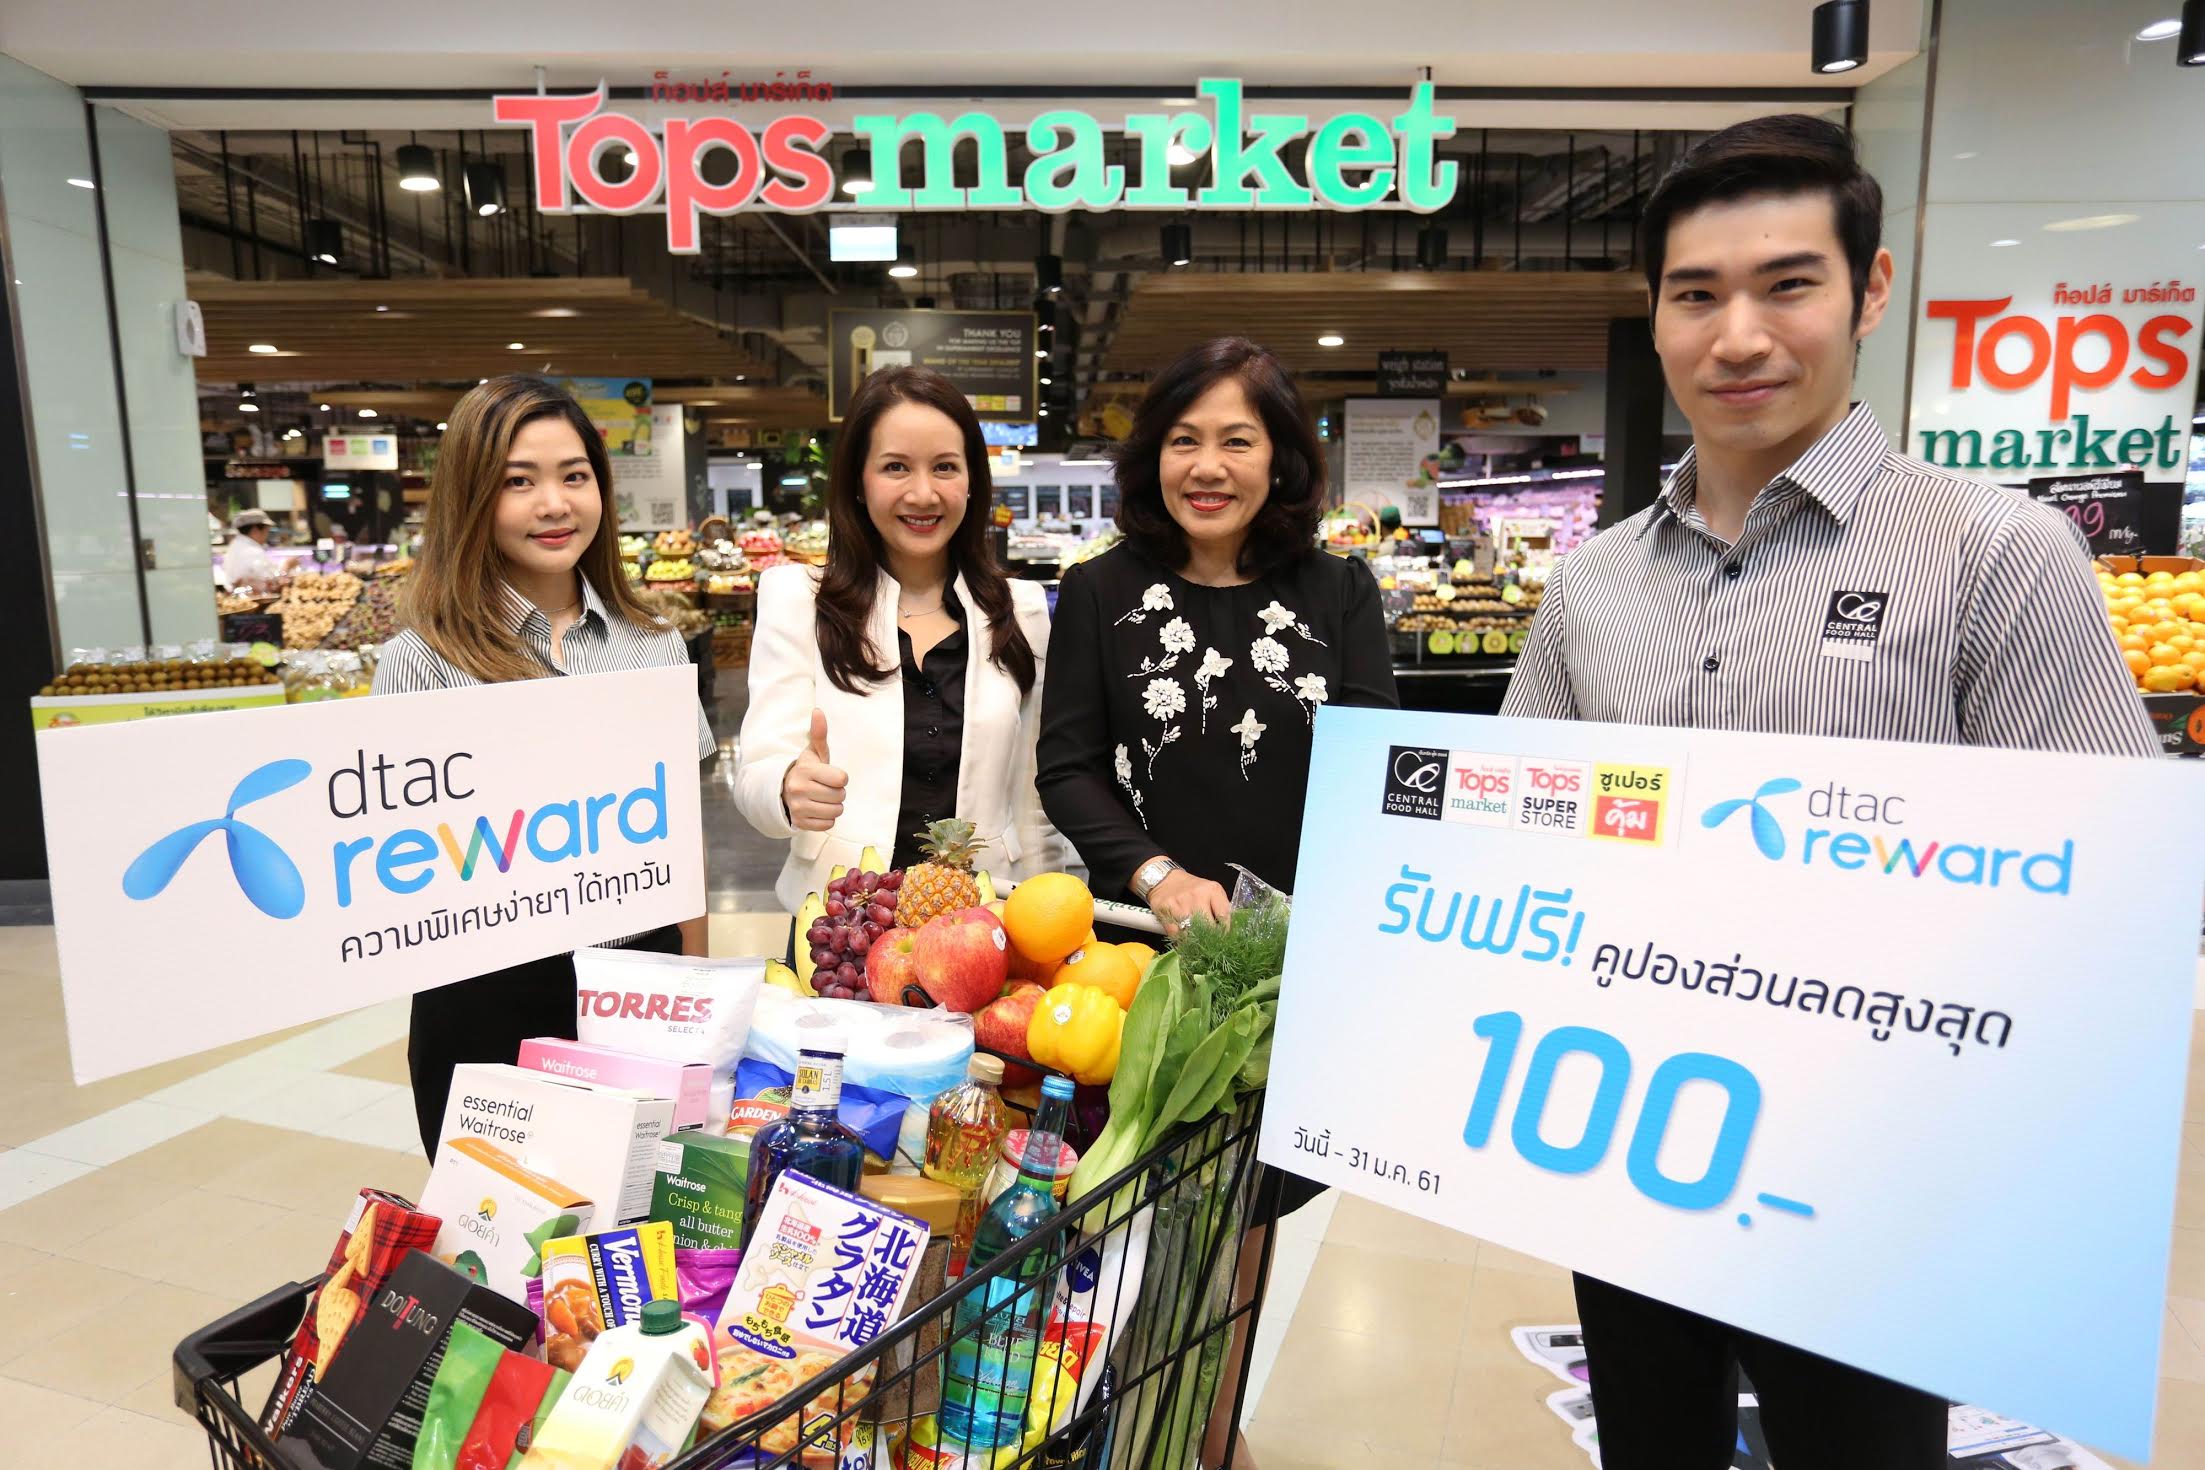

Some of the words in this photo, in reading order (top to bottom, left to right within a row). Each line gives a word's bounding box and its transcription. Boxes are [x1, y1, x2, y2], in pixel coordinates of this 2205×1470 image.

[653, 70, 730, 103] ท็อปส์
[739, 70, 833, 103] มาร์เก็ต
[493, 78, 835, 255] Tops
[853, 76, 1459, 212] market
[2054, 282, 2113, 305] ท็อปส์
[2123, 280, 2195, 303] มาร์เก็ต
[963, 328, 997, 338] THANK
[1000, 328, 1022, 339] YOU
[1927, 295, 2193, 421] Tops
[1919, 414, 2182, 470] market
[1825, 629, 1851, 637] FOOD
[1827, 621, 1877, 632] CENTRAL
[328, 748, 475, 819] dtac
[1455, 768, 1510, 799] Tops
[1526, 768, 1581, 797] Tops
[1600, 771, 1663, 792] ซูเปอร์
[1386, 802, 1412, 813] FOOD
[1415, 806, 1438, 816] HALL
[1387, 793, 1439, 807] CENTRAL
[1450, 798, 1508, 814] market
[1522, 796, 1577, 814] SUPER
[1808, 781, 1906, 825] dtac
[1521, 810, 1576, 829] STORE
[1605, 798, 1647, 837] คุ้ม
[333, 761, 668, 908] reward
[1803, 828, 2074, 897] reward
[341, 886, 569, 963] ความพิเศษง่ายๆ
[574, 860, 672, 906] ได้ทุกวัน
[1378, 864, 1586, 967] รับฟรี!
[1591, 941, 2012, 1057] คูปองส่วนลดสูงสุด
[578, 989, 714, 1023] TORRES
[541, 1056, 598, 1079] Waitrose
[463, 1094, 534, 1122] essential
[731, 1106, 782, 1122] GARDEN
[460, 1114, 526, 1144] Waitrose
[1294, 1126, 1331, 1157] วันนี้
[1349, 1147, 1368, 1171] 31
[1374, 1157, 1411, 1186] ม.ค.
[1418, 1170, 1441, 1195] 61
[666, 1174, 706, 1193] Waitrose
[668, 1192, 700, 1213] Crisp
[702, 1200, 712, 1214] &
[680, 1215, 695, 1229] all
[698, 1217, 734, 1238] butter
[673, 1234, 698, 1249] nion
[590, 1243, 603, 1267] CURRY
[596, 1267, 608, 1287] WITH
[806, 1212, 881, 1330] グラタン
[1070, 1260, 1094, 1282] IVEA
[840, 1226, 916, 1347] 北海道
[381, 1290, 438, 1334] DOITUNG
[601, 1293, 613, 1316] TOUCH
